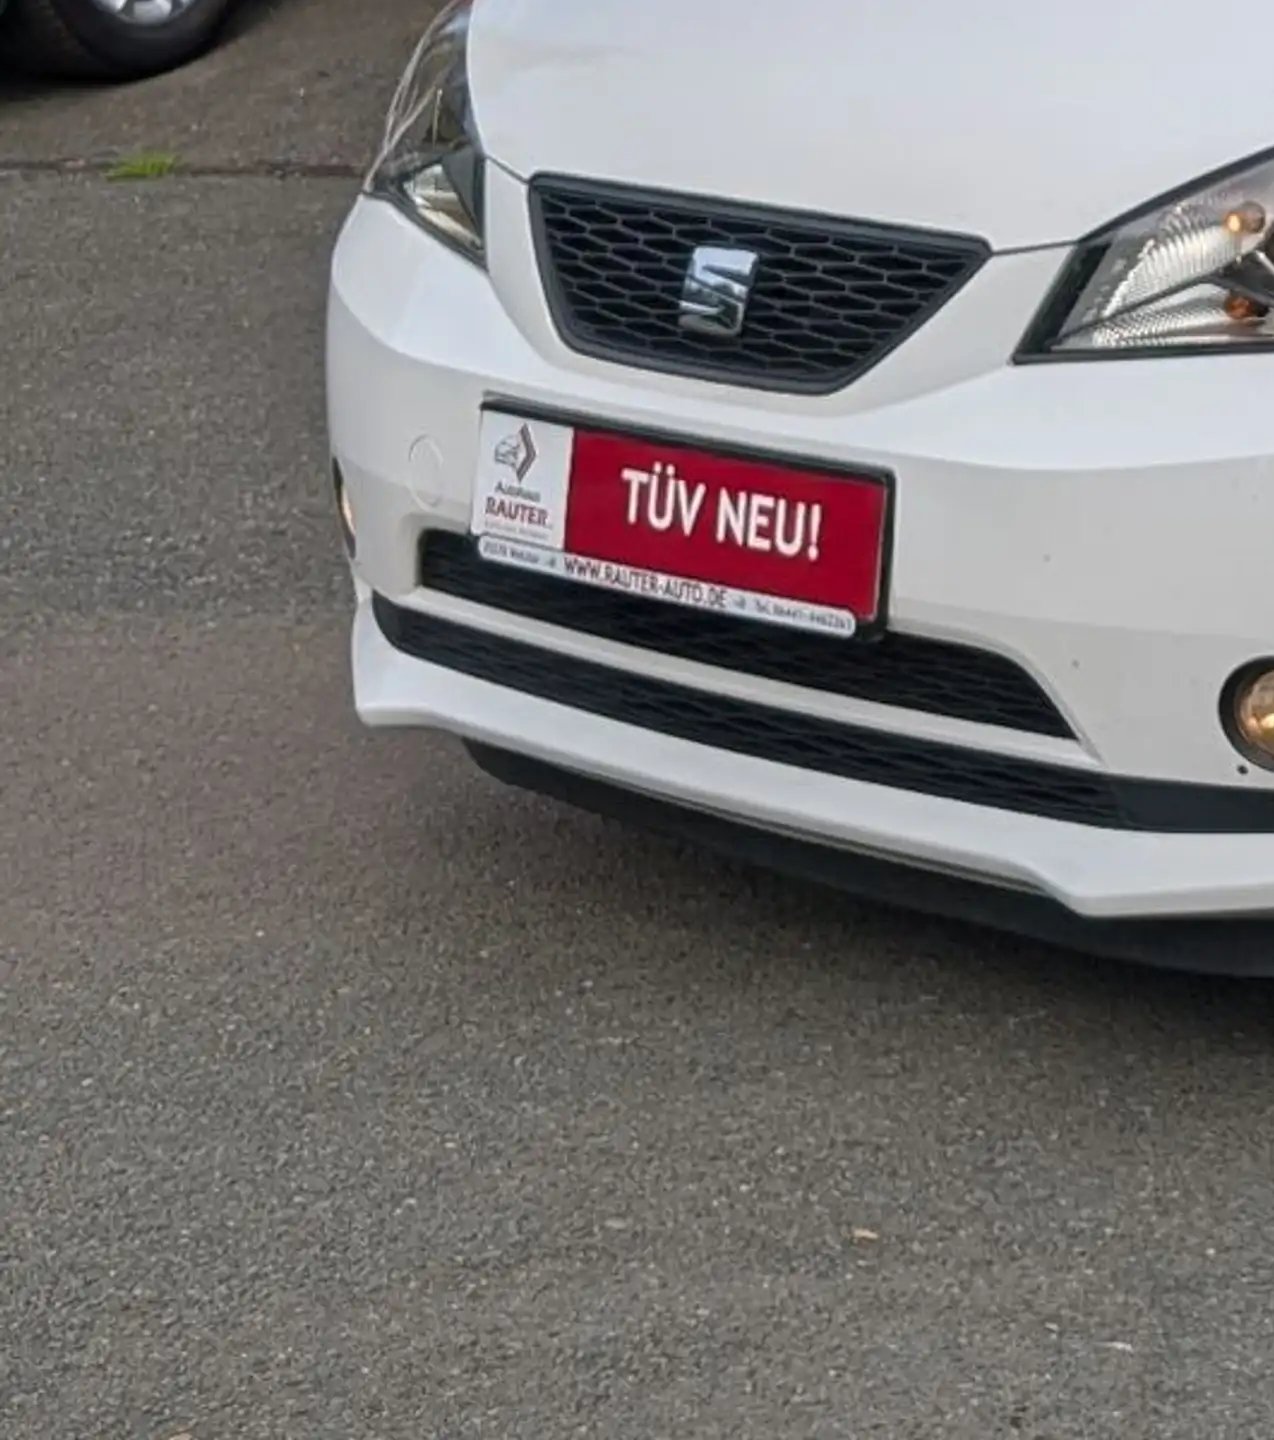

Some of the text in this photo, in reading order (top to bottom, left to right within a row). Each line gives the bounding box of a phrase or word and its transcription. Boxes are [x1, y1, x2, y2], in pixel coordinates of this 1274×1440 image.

[484, 496, 549, 527] RAUTER
[621, 461, 822, 562] TÜV NEU!
[563, 555, 728, 609] WWW.RAUTER-AUTO.DE
